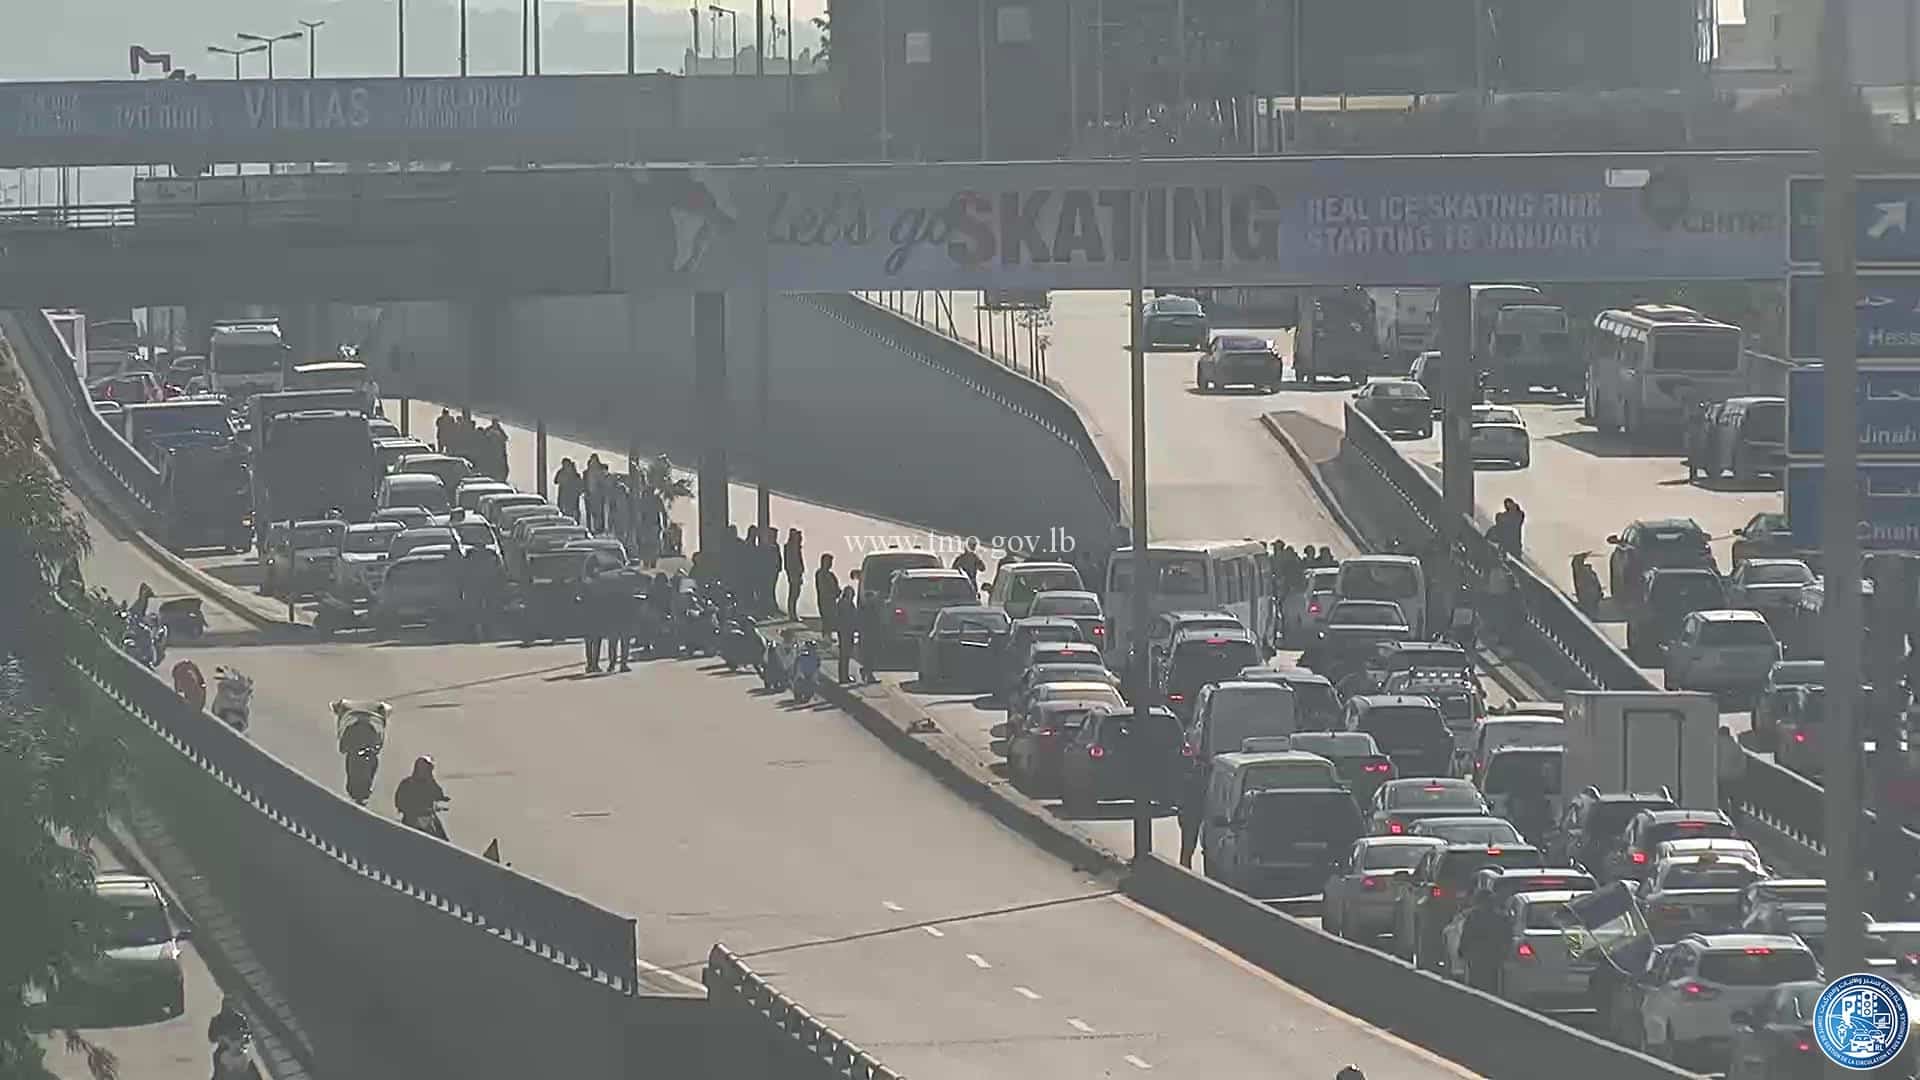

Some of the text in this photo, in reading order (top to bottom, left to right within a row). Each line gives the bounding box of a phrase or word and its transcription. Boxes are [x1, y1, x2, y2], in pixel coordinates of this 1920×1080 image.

[243, 86, 369, 129] VILLAS
[946, 185, 1281, 265] SKATING
[1305, 196, 1369, 224] REAL
[1380, 194, 1418, 222] ICE
[1427, 192, 1537, 220] SKATING
[885, 208, 948, 275] go
[1304, 225, 1433, 256] STARTING
[1487, 222, 1602, 252] JANUARY
